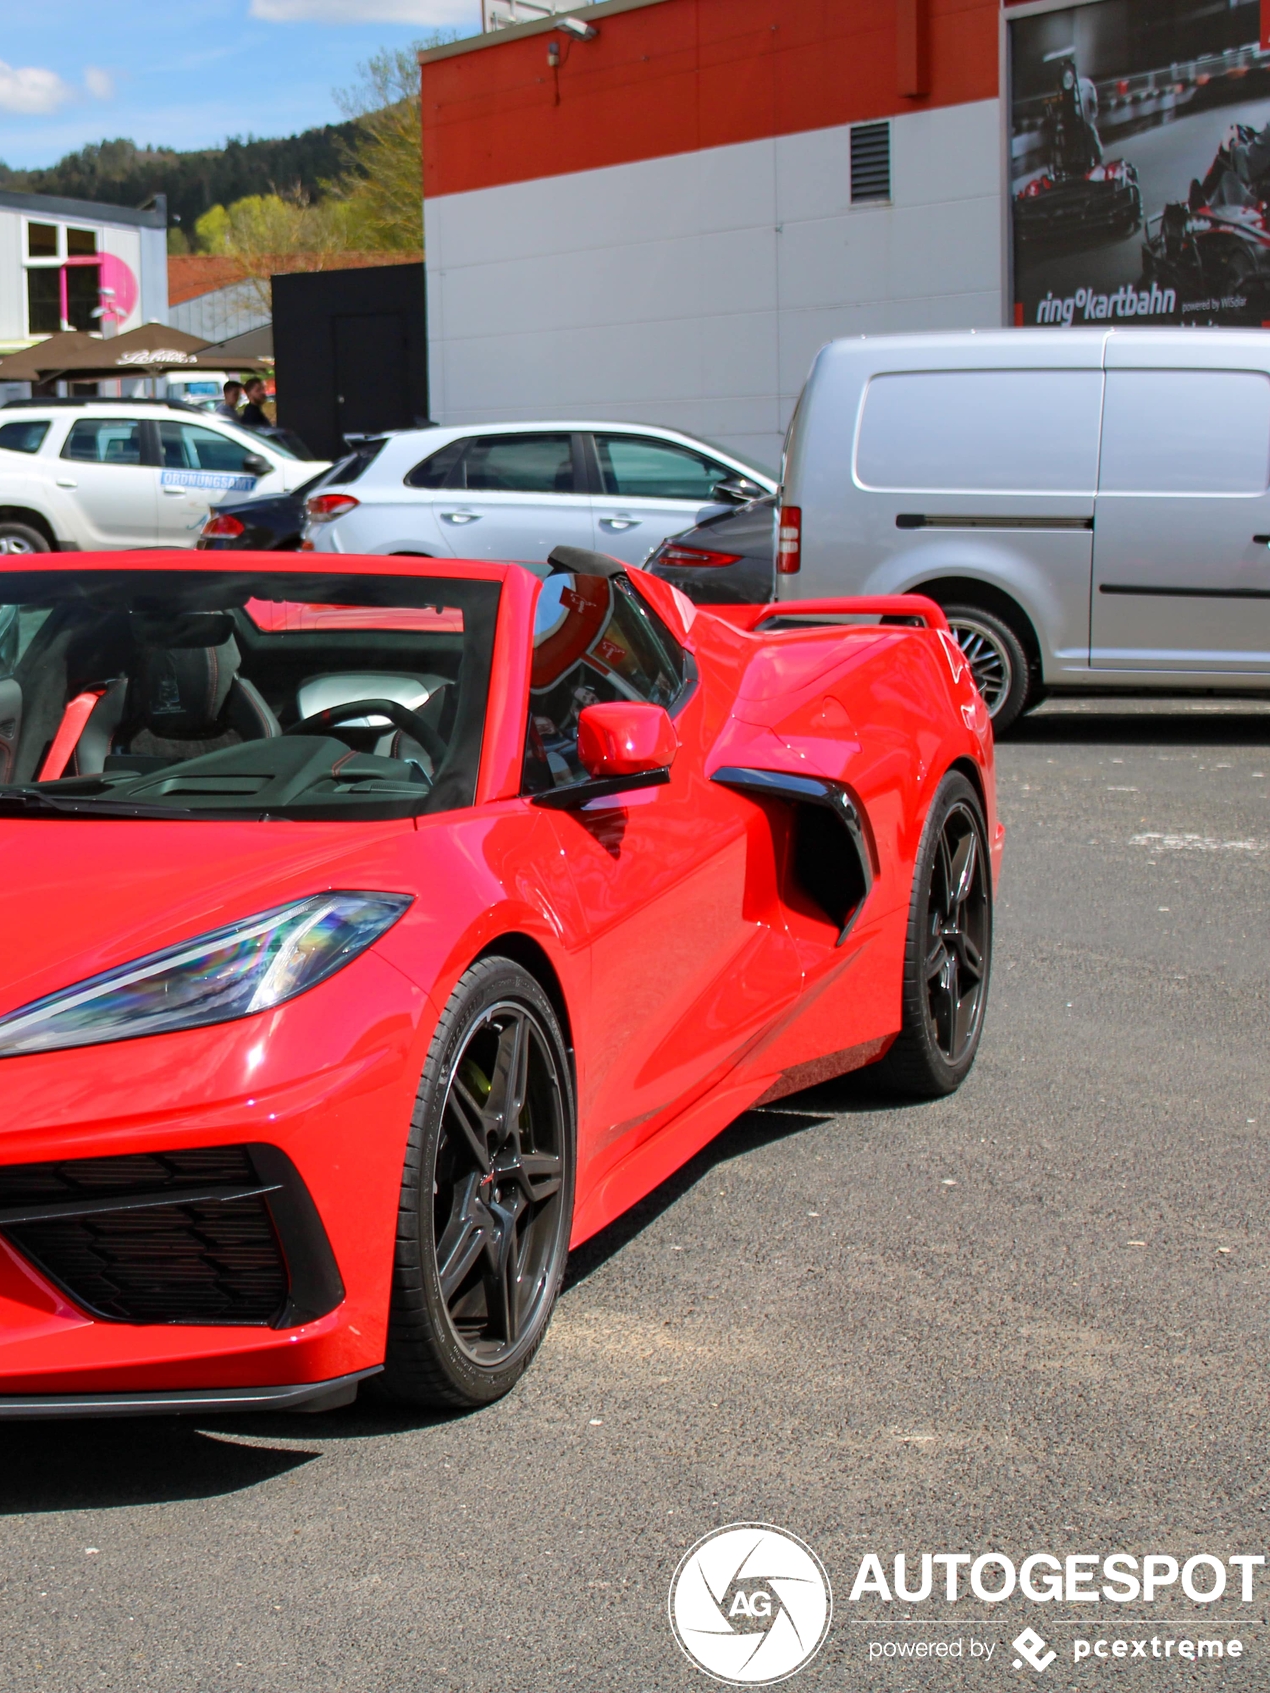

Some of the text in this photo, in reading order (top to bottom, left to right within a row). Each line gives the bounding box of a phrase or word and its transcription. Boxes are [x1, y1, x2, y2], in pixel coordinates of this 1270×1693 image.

[1182, 298, 1211, 314] powered
[1211, 297, 1220, 312] by
[163, 472, 255, 490] ORDNUNGSAMT
